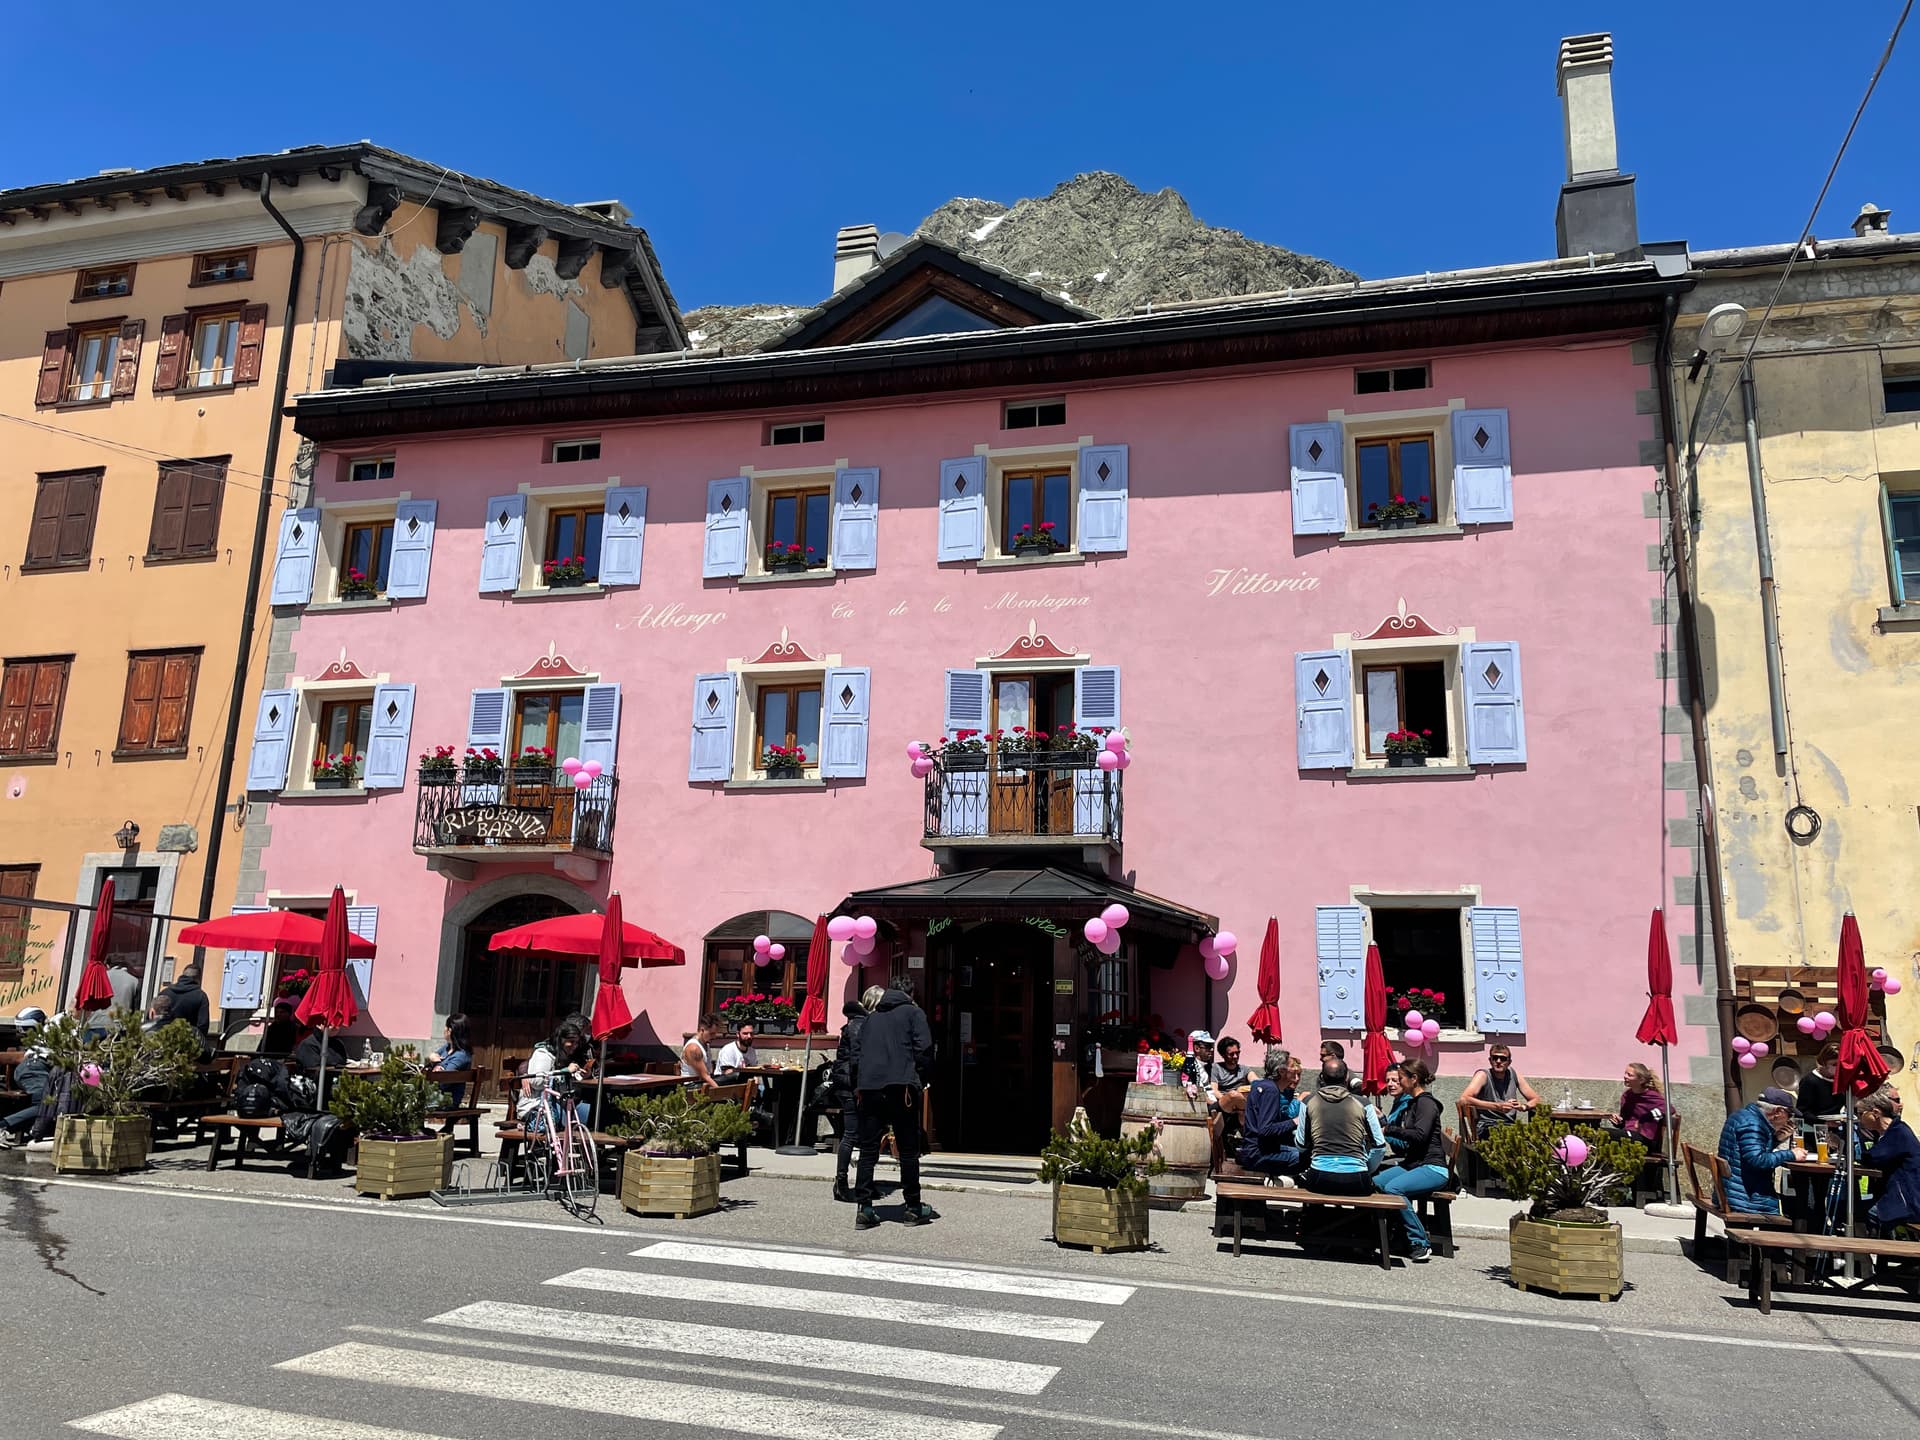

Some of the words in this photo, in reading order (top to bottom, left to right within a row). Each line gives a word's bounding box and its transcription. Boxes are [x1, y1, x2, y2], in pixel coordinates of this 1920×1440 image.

[1204, 567, 1321, 597] Vittoria
[615, 601, 728, 634] Albergo
[831, 601, 856, 619] Ca
[888, 600, 909, 617] de
[932, 595, 953, 613] la
[984, 591, 1091, 613] Montagna
[443, 807, 546, 838] RISTORANTE
[477, 822, 513, 837] BAR
[0, 974, 54, 1007] ittoria
